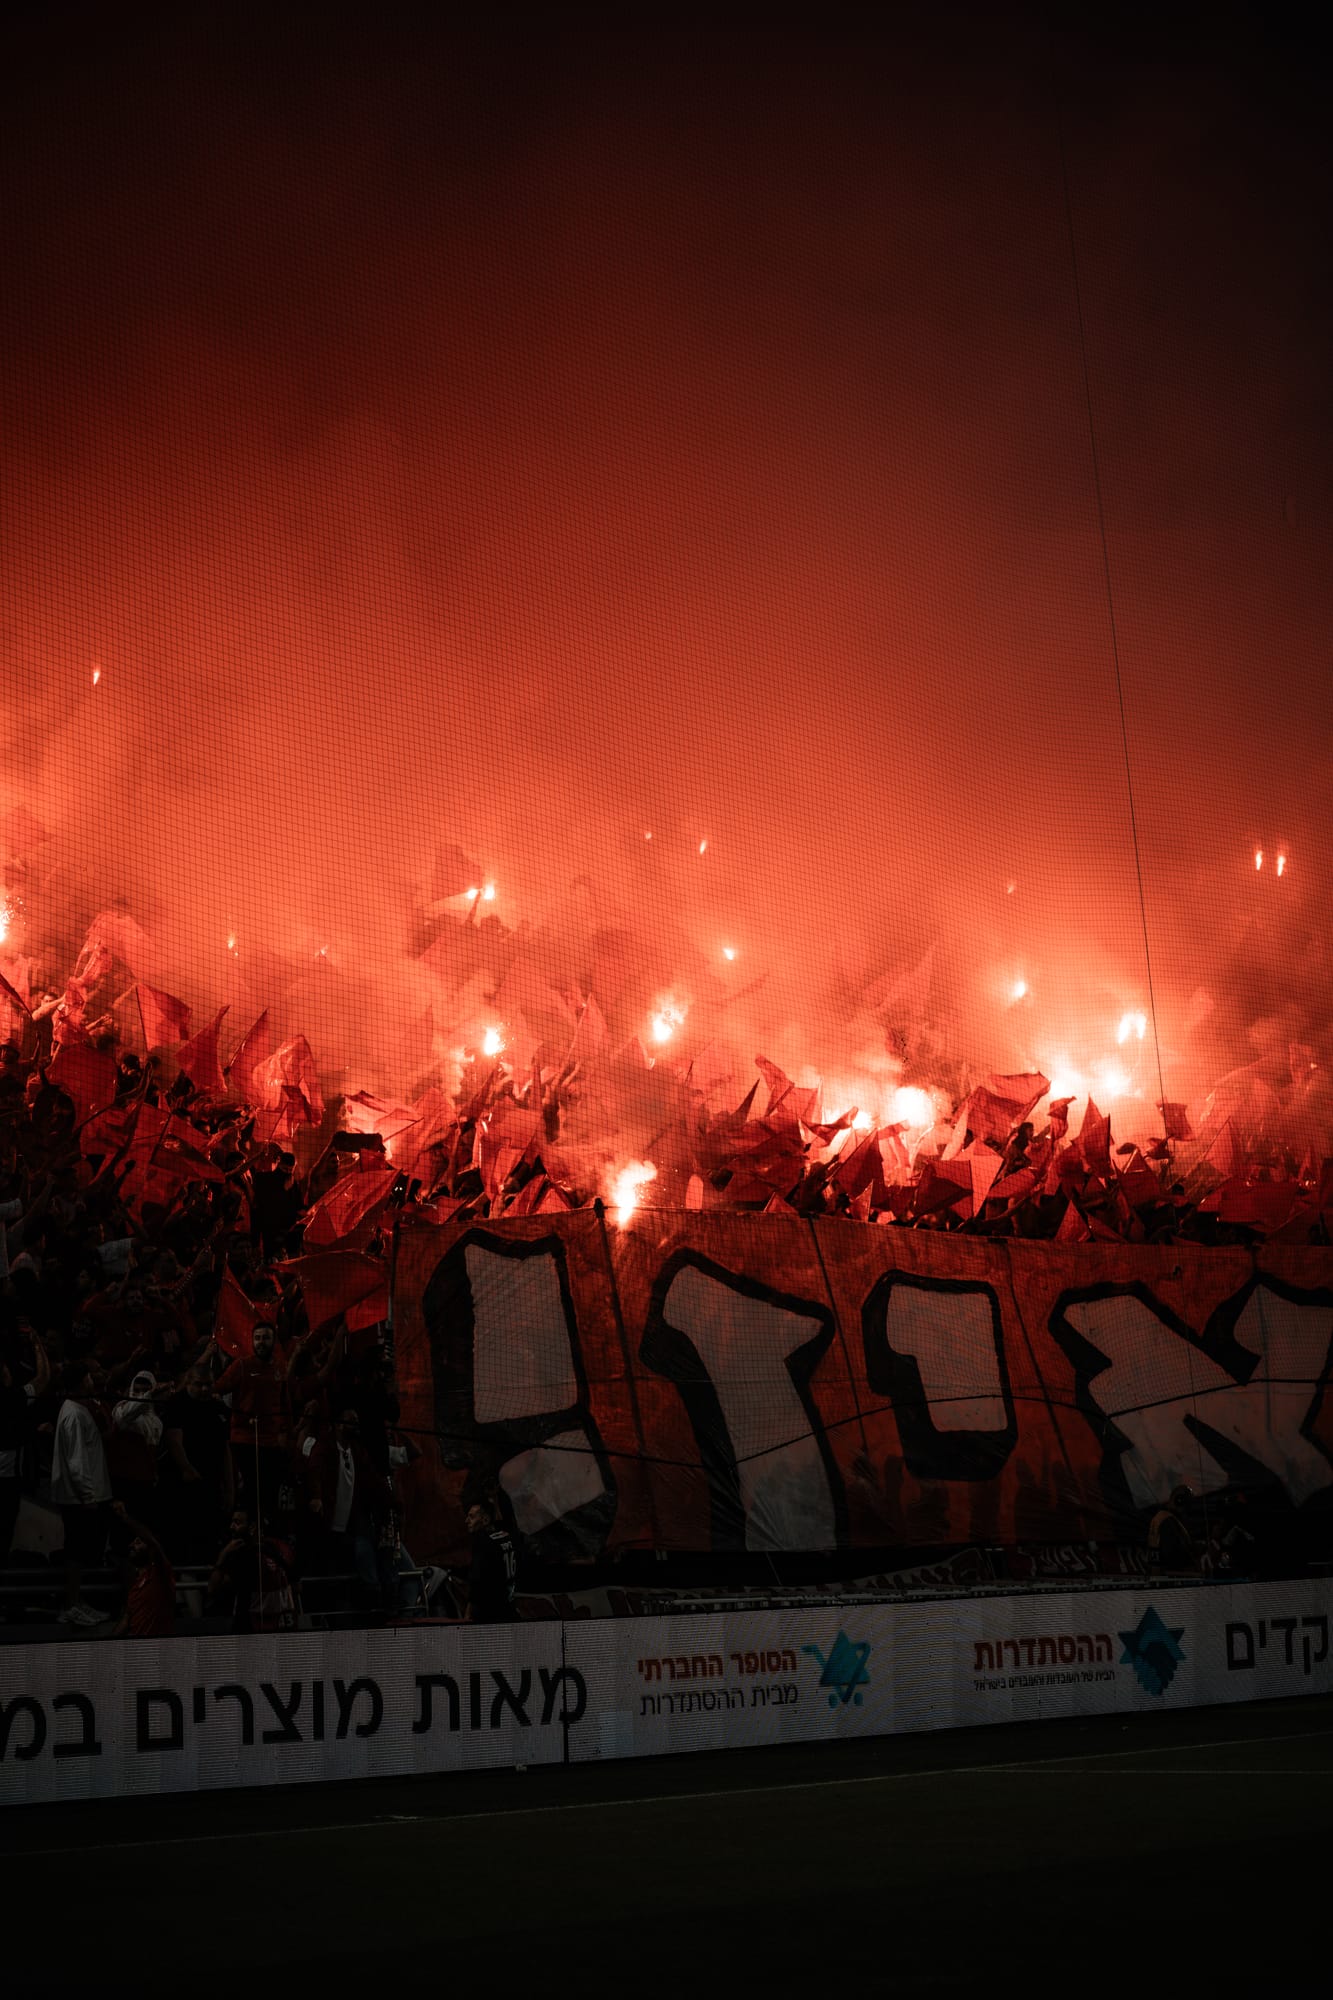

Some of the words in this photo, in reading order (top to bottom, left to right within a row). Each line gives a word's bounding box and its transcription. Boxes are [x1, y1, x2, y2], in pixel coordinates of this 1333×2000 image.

[730, 1649, 797, 1674] הסופר
[974, 1633, 1113, 1670] ההסתדרות
[638, 1654, 723, 1681] החברתי
[412, 1667, 587, 1734] מאות
[640, 1688, 745, 1715] ההסתדרות
[751, 1683, 798, 1707] מבית
[136, 1677, 384, 1752] מוצרים
